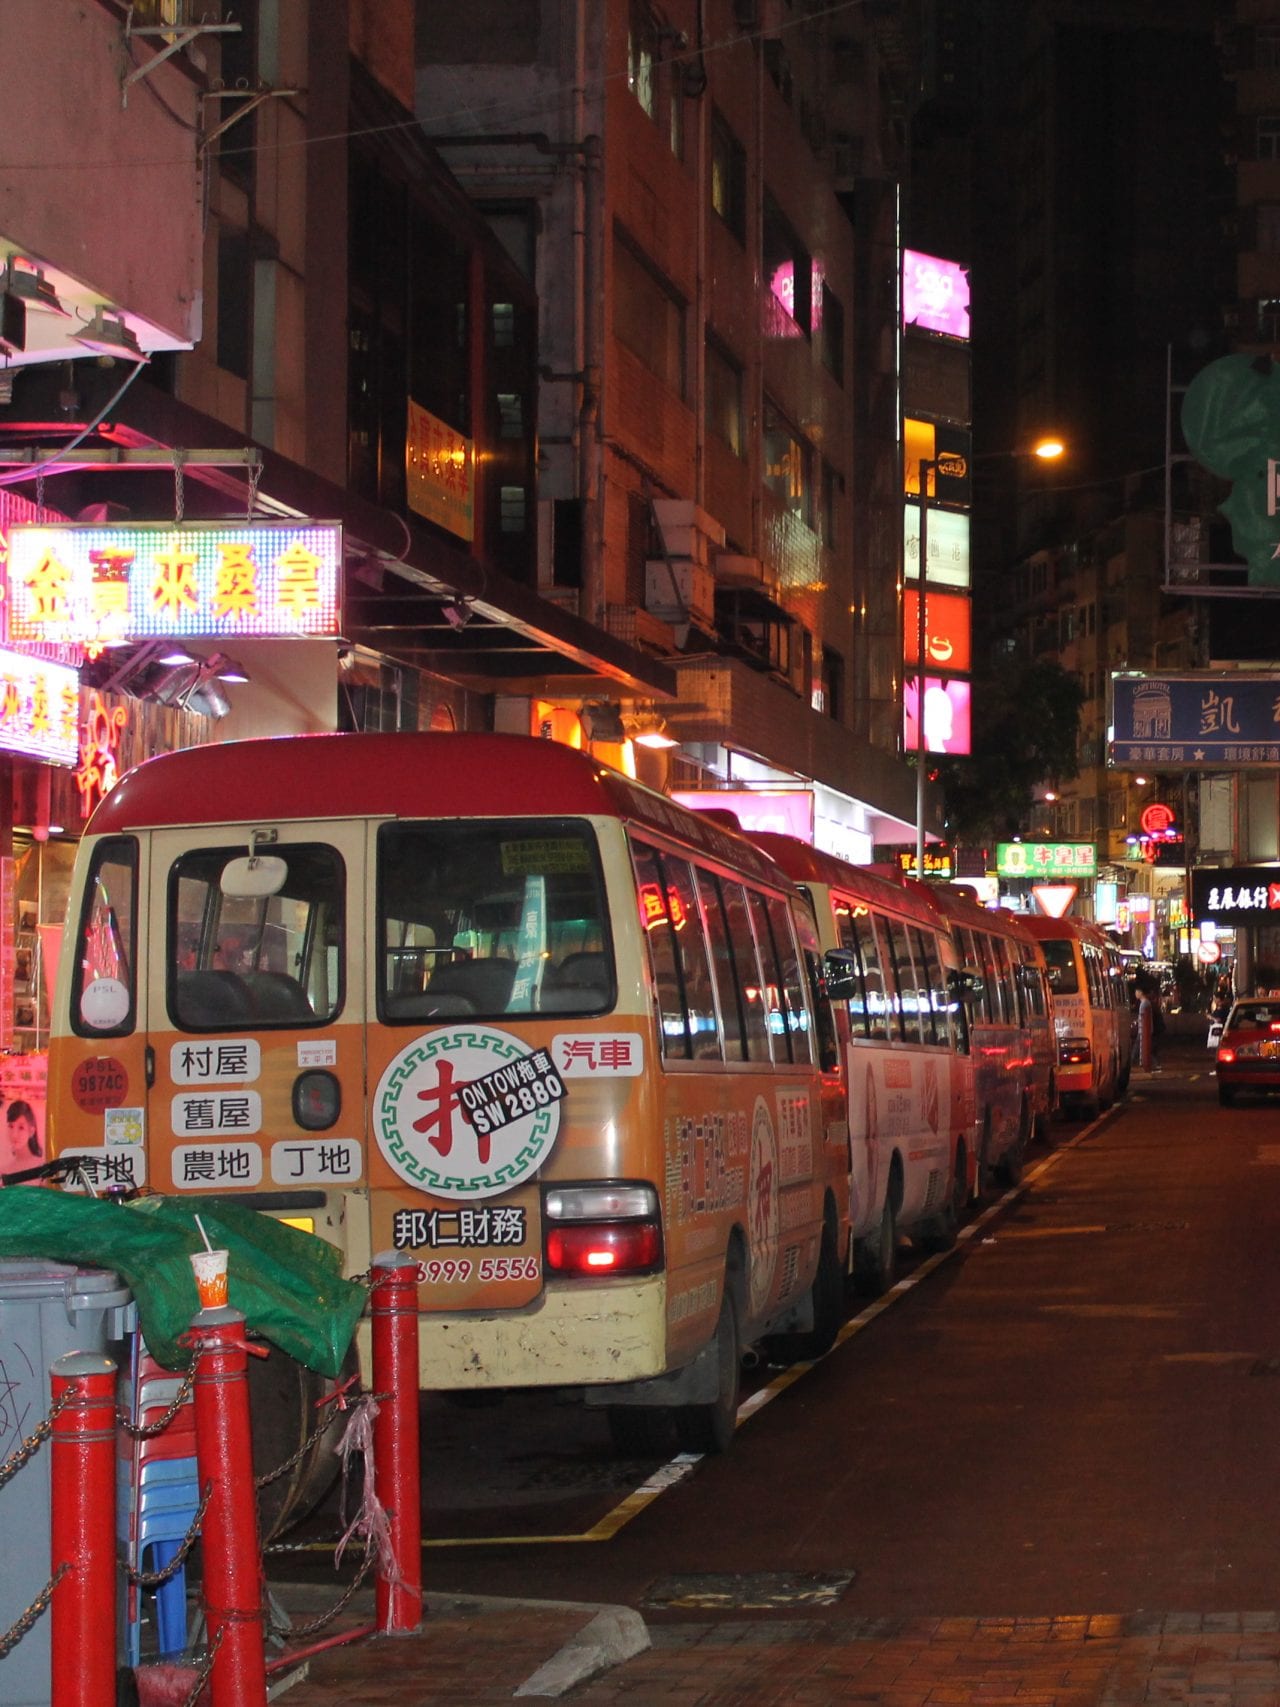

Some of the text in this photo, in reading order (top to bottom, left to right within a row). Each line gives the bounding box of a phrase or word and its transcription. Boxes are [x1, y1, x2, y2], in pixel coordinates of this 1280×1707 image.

[181, 1045, 249, 1078] 村屋
[563, 1040, 632, 1070] 汽車
[79, 1075, 124, 1092] 9874C
[462, 1081, 488, 1109] ON
[484, 1065, 520, 1097] TOW
[184, 1098, 250, 1130] 舊屋
[473, 1075, 562, 1133] SW 2880
[183, 1149, 250, 1181] 農地
[284, 1145, 351, 1176] 丁地
[396, 1208, 523, 1247] 邦仁財務
[415, 1258, 538, 1283] 6999 5556
